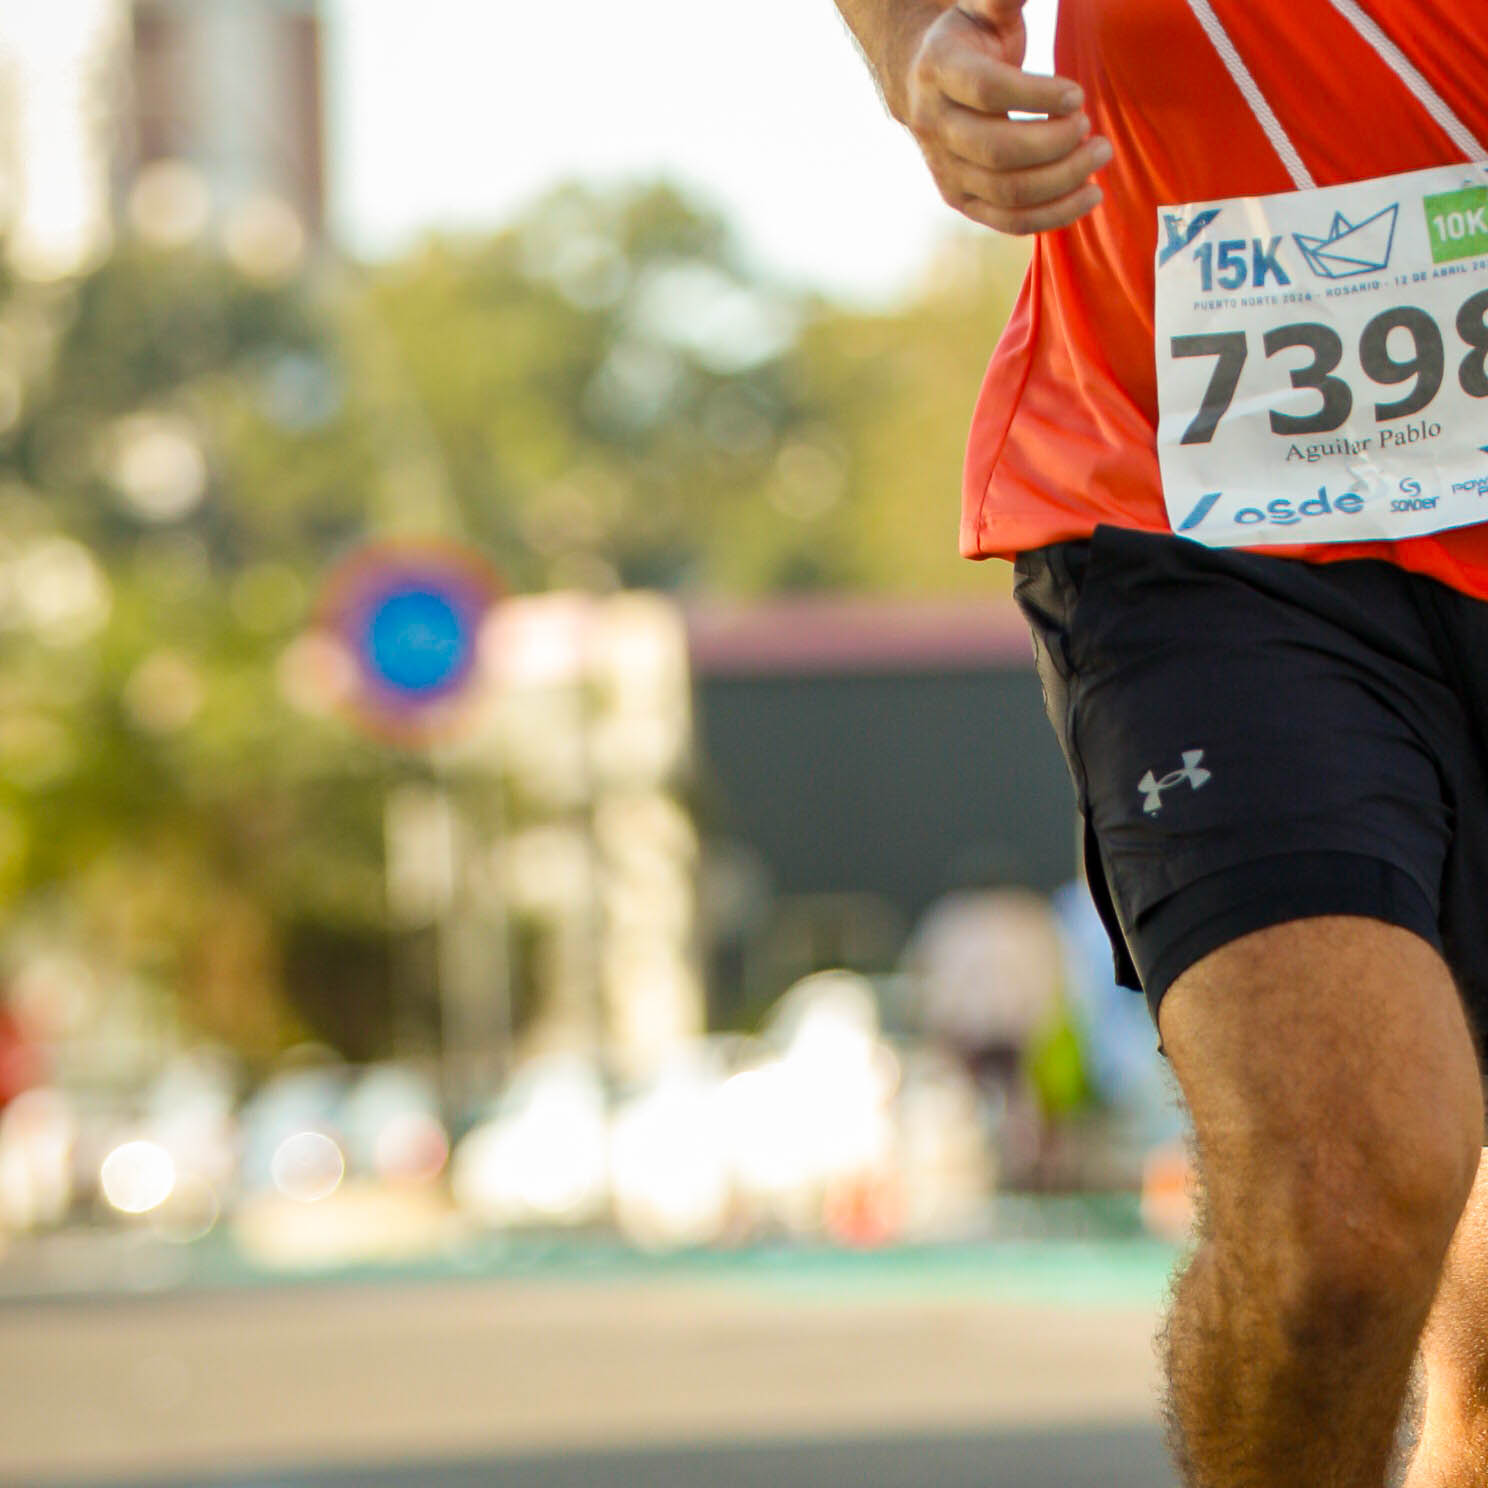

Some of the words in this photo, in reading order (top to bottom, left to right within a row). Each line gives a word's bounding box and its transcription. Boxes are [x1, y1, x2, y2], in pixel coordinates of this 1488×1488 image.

[1432, 207, 1488, 243] 10K
[1193, 235, 1291, 292] 15K
[1193, 298, 1237, 311] PUERTO
[1241, 295, 1278, 307] NORTE
[1325, 279, 1380, 297] ROSARIO
[1395, 276, 1407, 288] 12
[1412, 271, 1427, 283] DE
[1432, 264, 1467, 279] ABRIL
[1285, 437, 1373, 462] Aguilar
[1379, 420, 1442, 449] Pablo
[1233, 485, 1366, 525] osde
